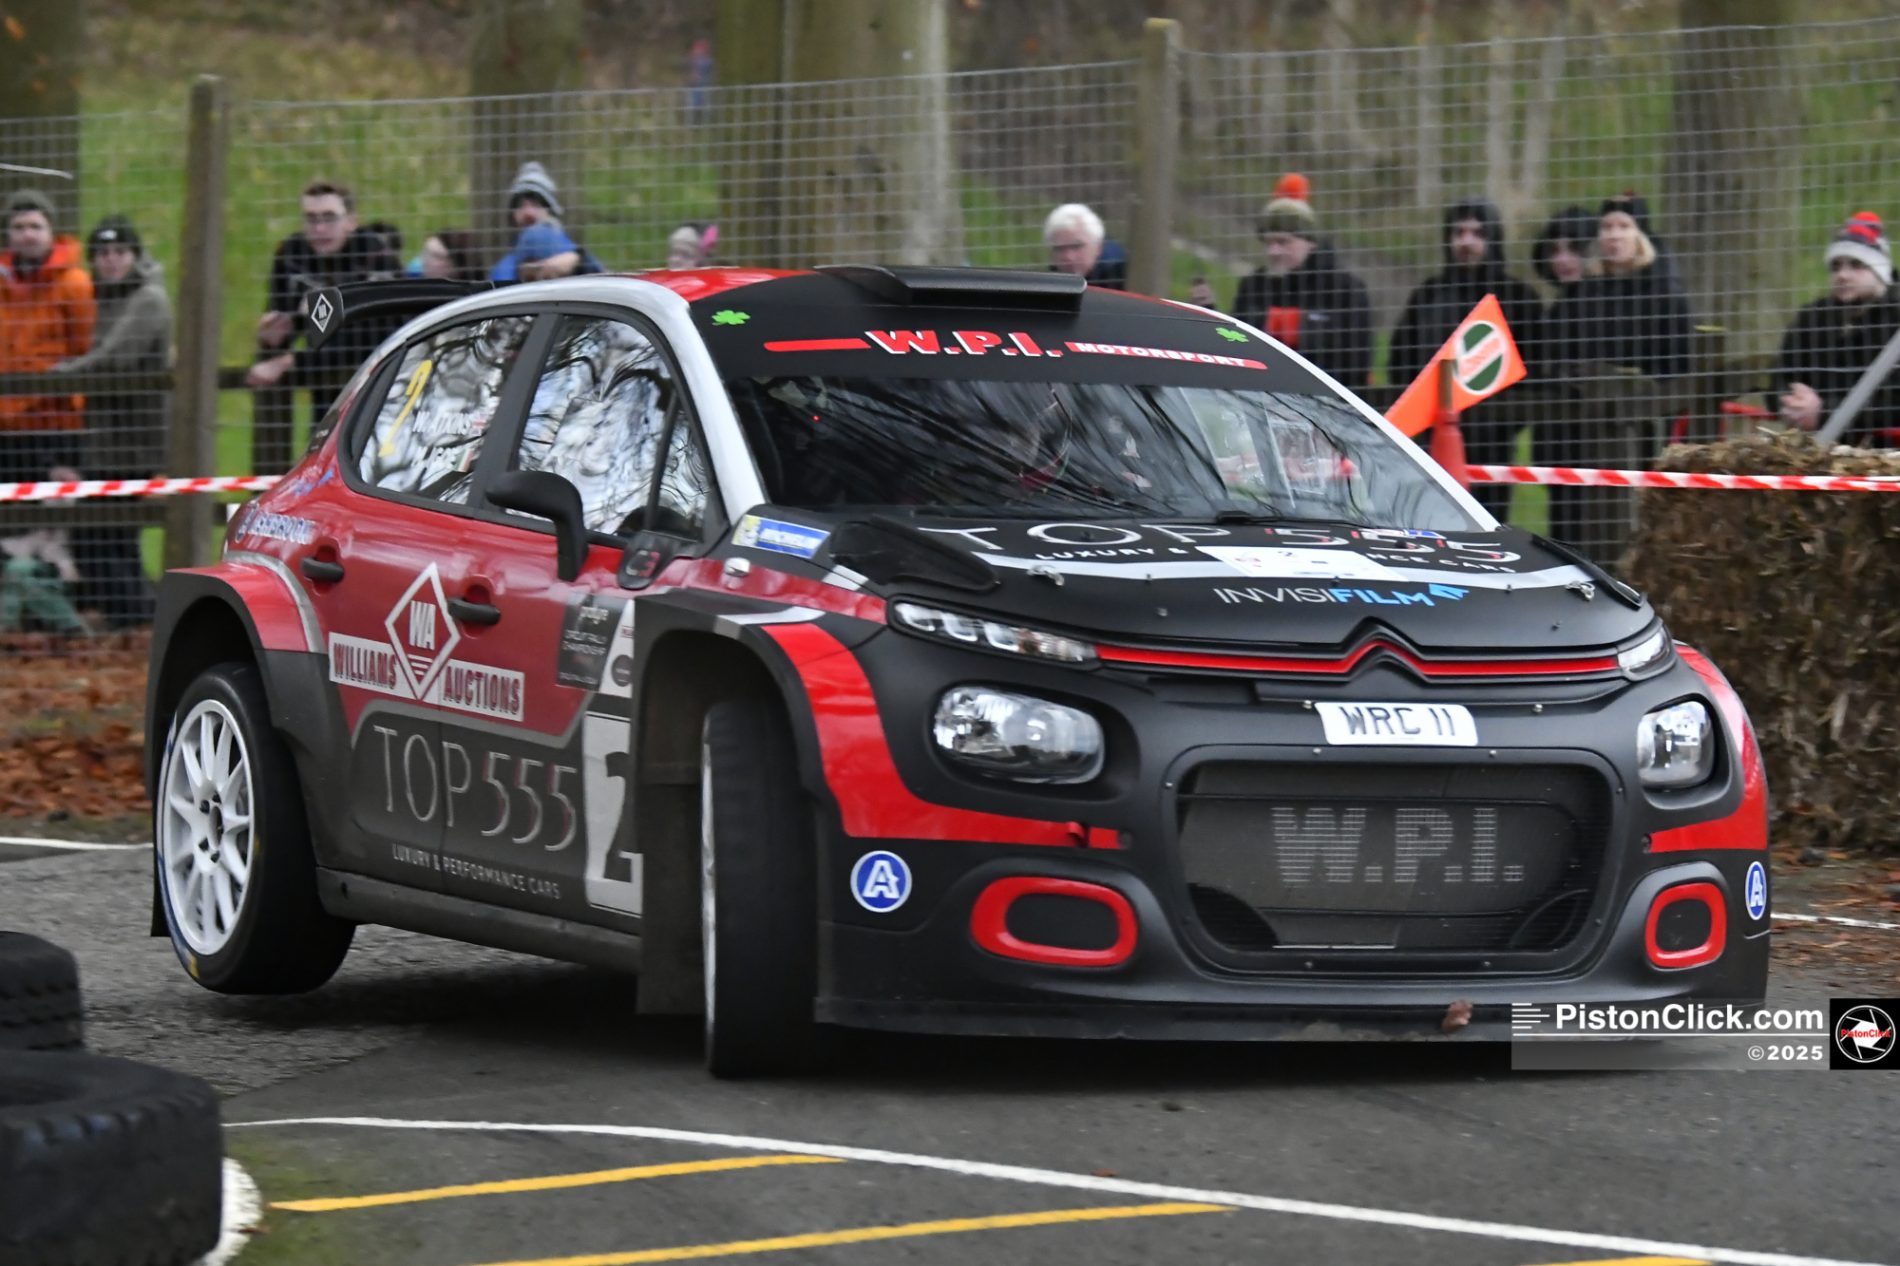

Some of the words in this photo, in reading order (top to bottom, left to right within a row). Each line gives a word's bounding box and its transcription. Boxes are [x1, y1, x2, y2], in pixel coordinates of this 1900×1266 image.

[864, 329, 1064, 357] W.P.I.
[1073, 342, 1248, 367] MOTORSPORT
[917, 523, 1231, 550] TOP
[1265, 527, 1521, 561] 555
[1035, 548, 1155, 560] LUXURY
[1213, 587, 1436, 606] INVISIFILM
[333, 642, 398, 691] WILLIAMS
[443, 665, 521, 715] AUCTIONS
[1338, 706, 1421, 735] WRC
[373, 725, 471, 827] TOP
[481, 751, 577, 851] 555
[1270, 807, 1524, 883] W.P.I.
[392, 842, 431, 868] LUXURY
[443, 855, 526, 892] PERFORMANCE
[528, 877, 561, 900] CARS
